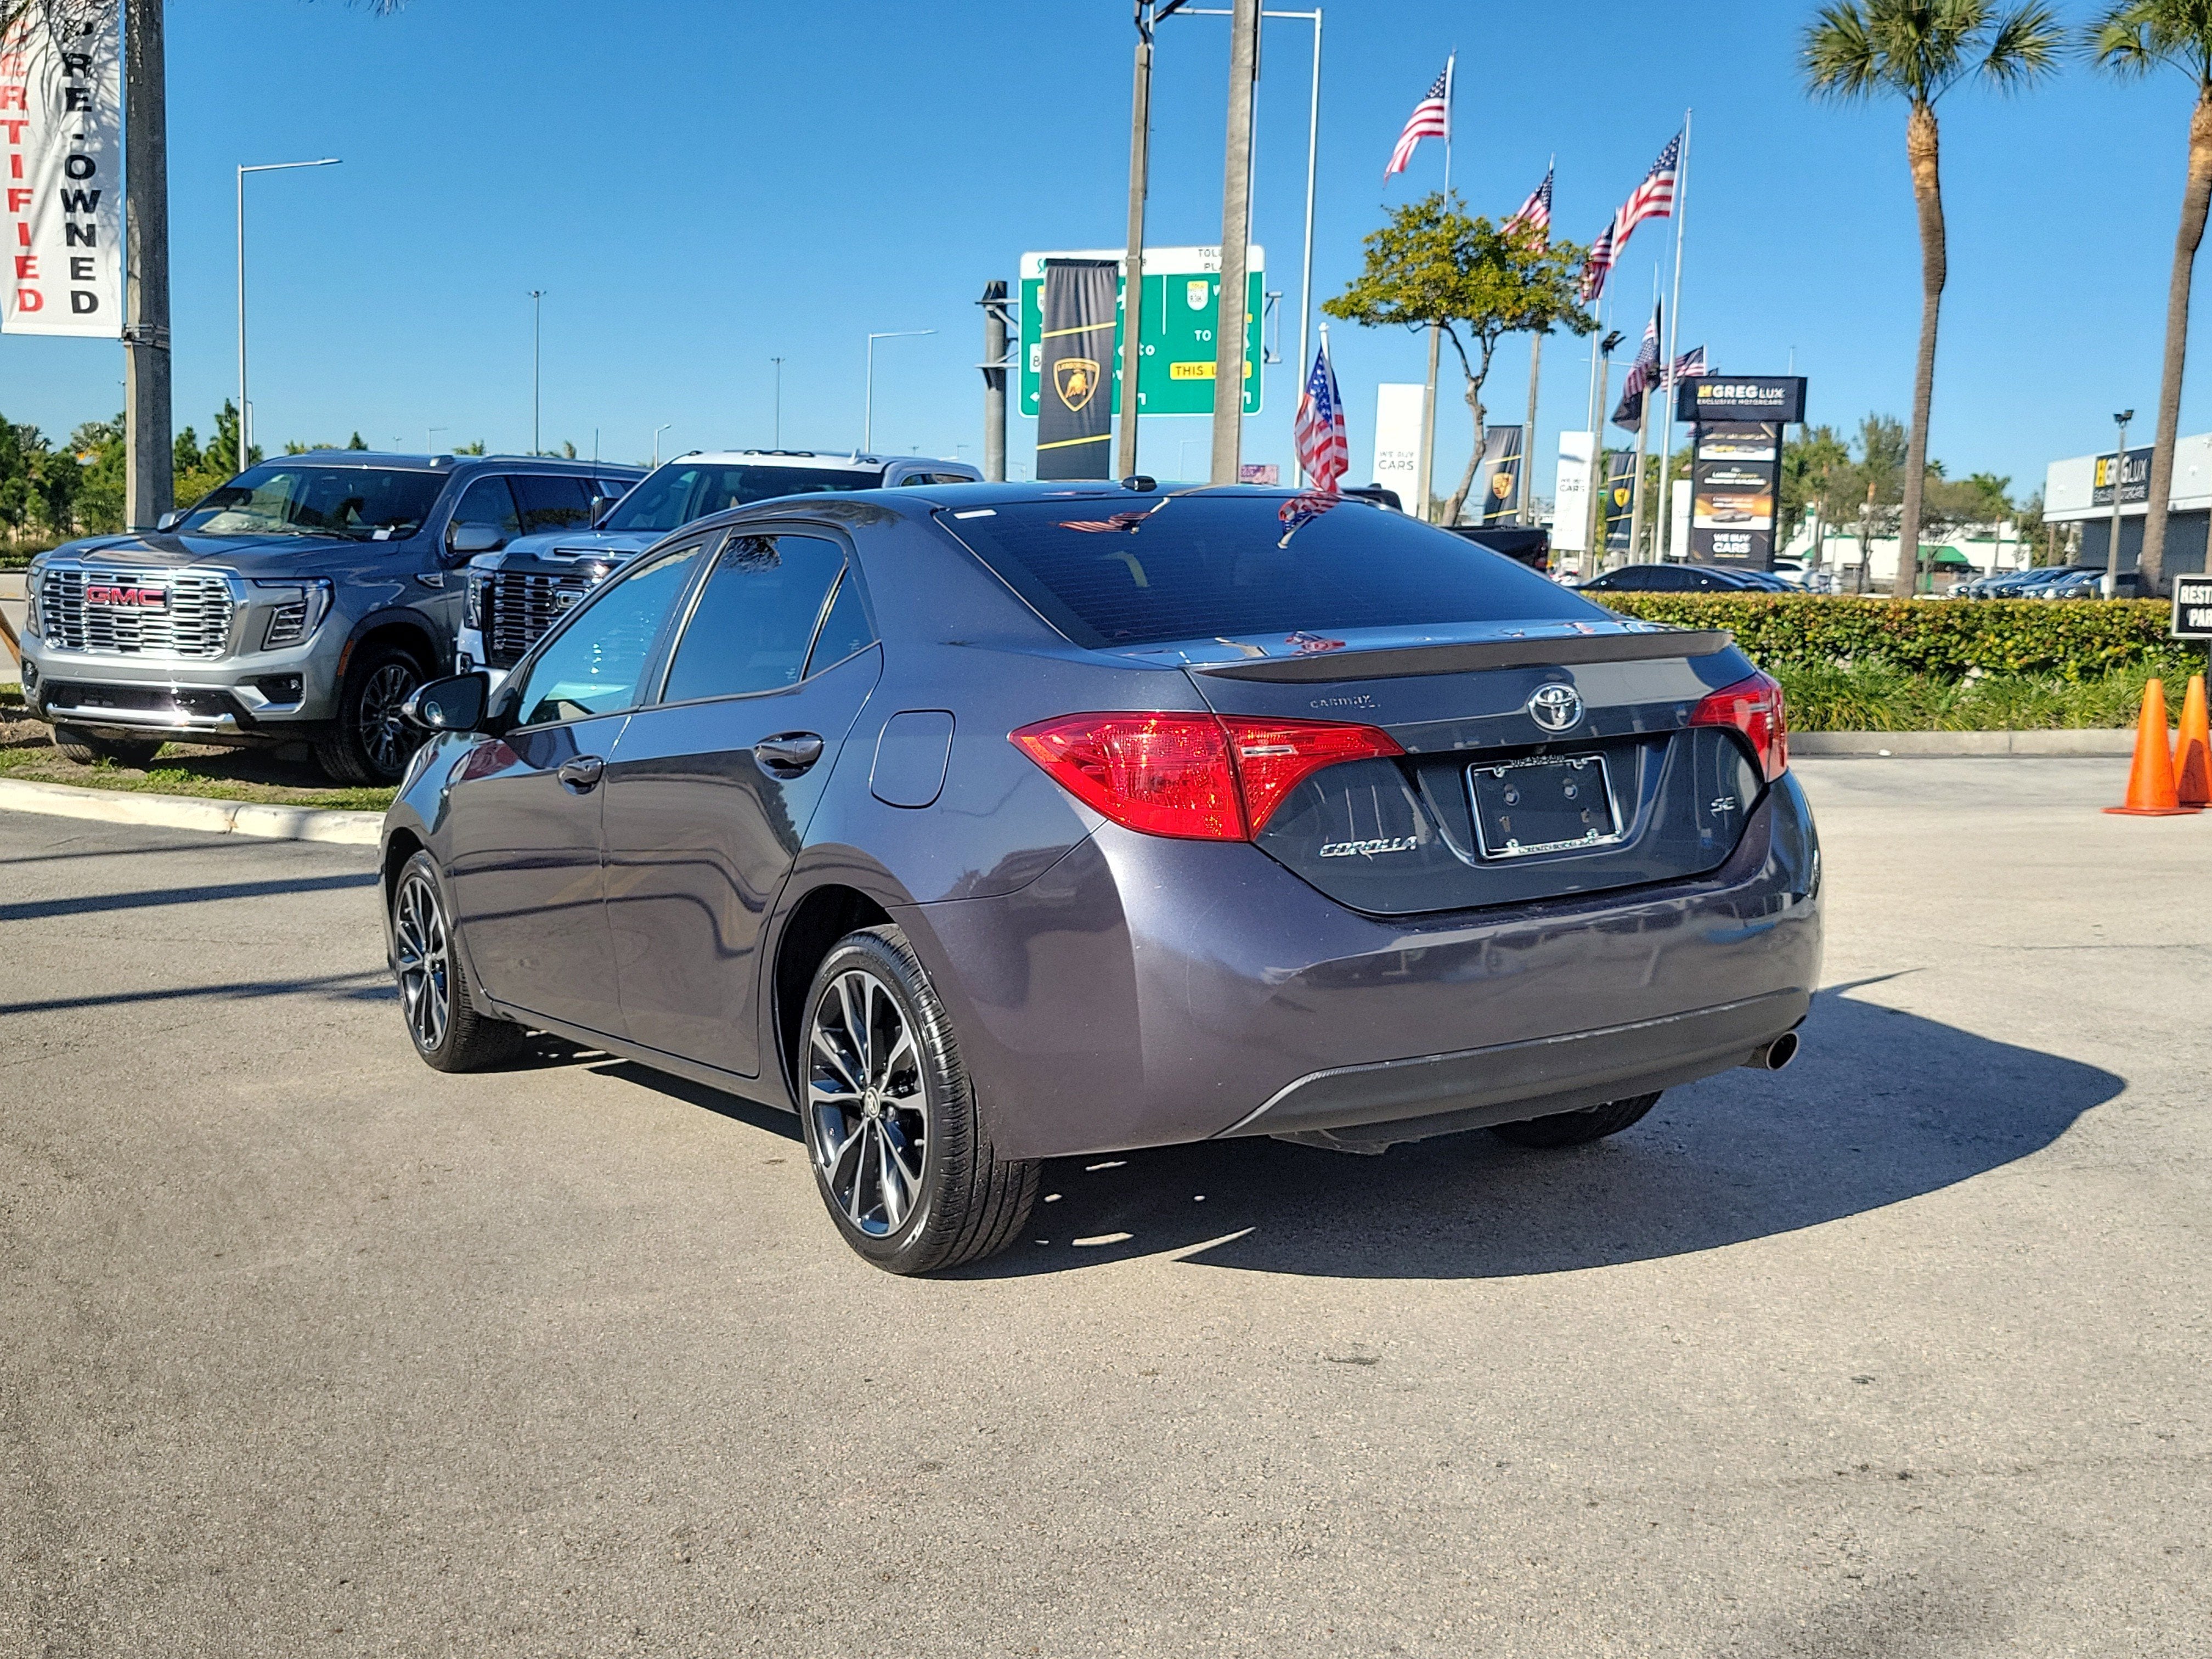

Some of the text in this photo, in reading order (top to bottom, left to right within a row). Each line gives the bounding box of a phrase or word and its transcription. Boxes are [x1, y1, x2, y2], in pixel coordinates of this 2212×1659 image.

[1194, 329, 1212, 341] TO
[1176, 366, 1204, 376] THIS
[1379, 460, 1414, 471] CARS
[1713, 542, 1751, 554] CARS
[87, 586, 165, 607] GMC
[1710, 797, 1735, 812] SE
[1319, 836, 1417, 858] COROLLA
